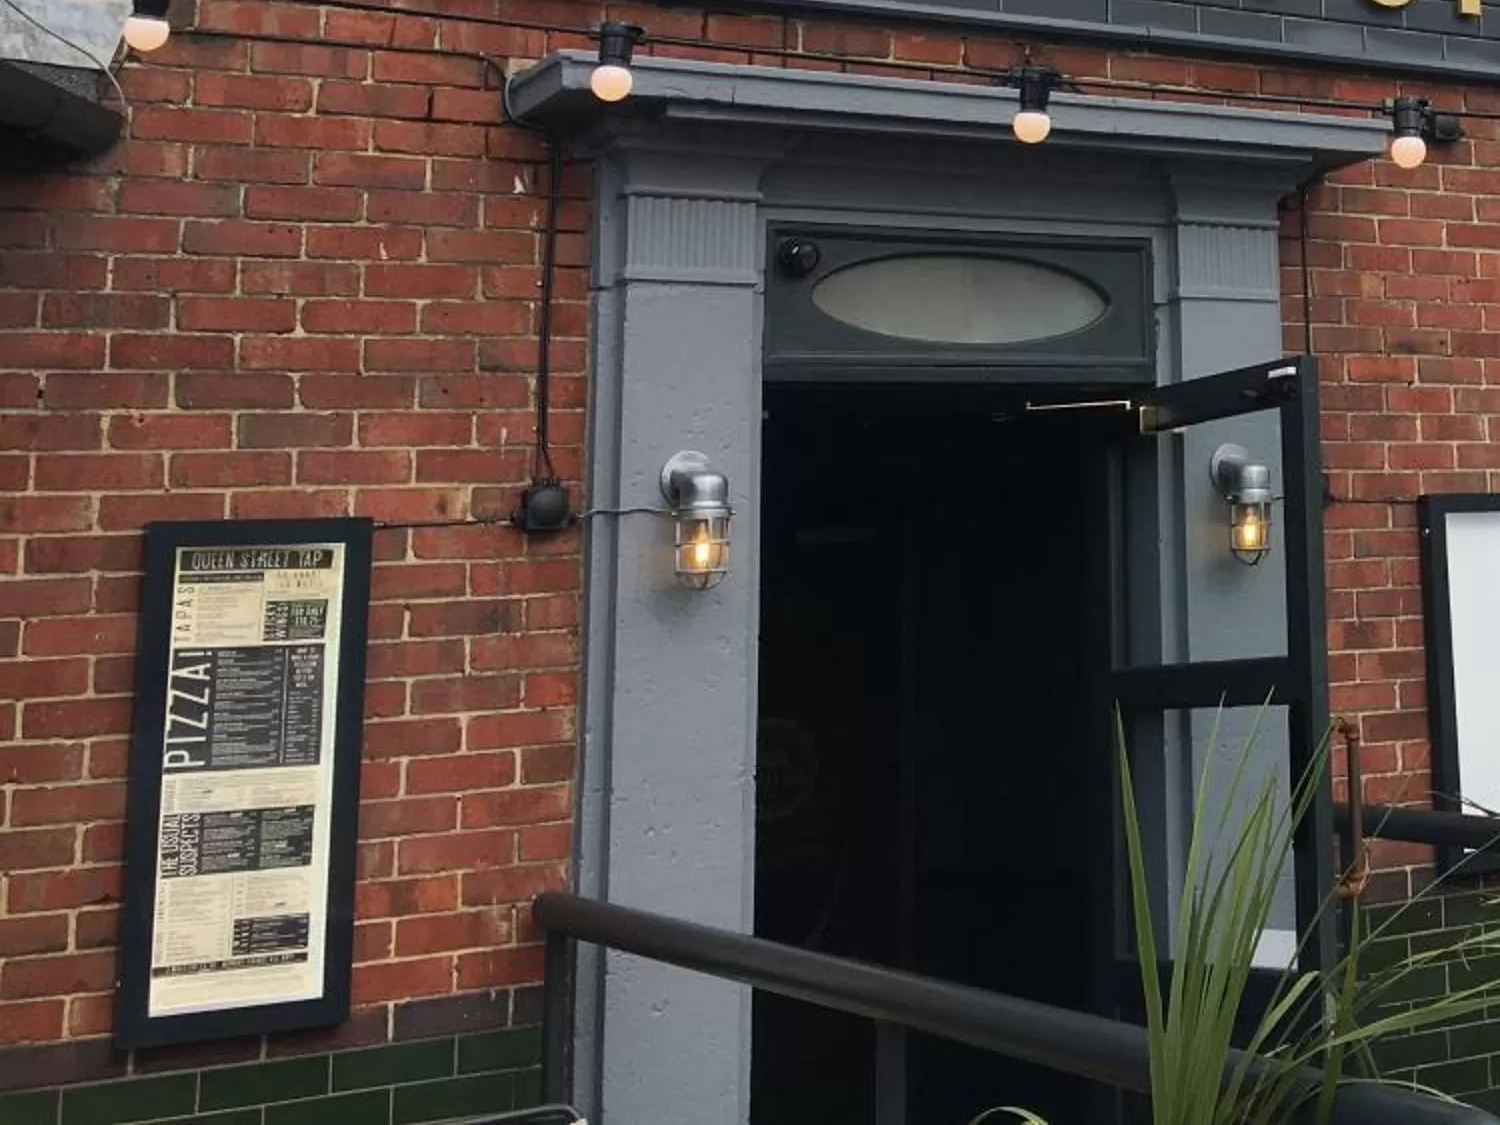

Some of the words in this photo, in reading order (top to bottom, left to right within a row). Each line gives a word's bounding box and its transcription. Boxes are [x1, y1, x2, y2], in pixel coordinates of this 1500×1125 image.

[191, 552, 235, 570] QUEEN
[240, 550, 289, 569] STREET
[298, 551, 323, 567] TAP
[174, 586, 195, 643] TAPAS
[163, 651, 213, 768] PIZZA!
[161, 813, 181, 854] USUAL
[179, 813, 201, 876] SUSPECTS
[161, 856, 178, 876] THE
